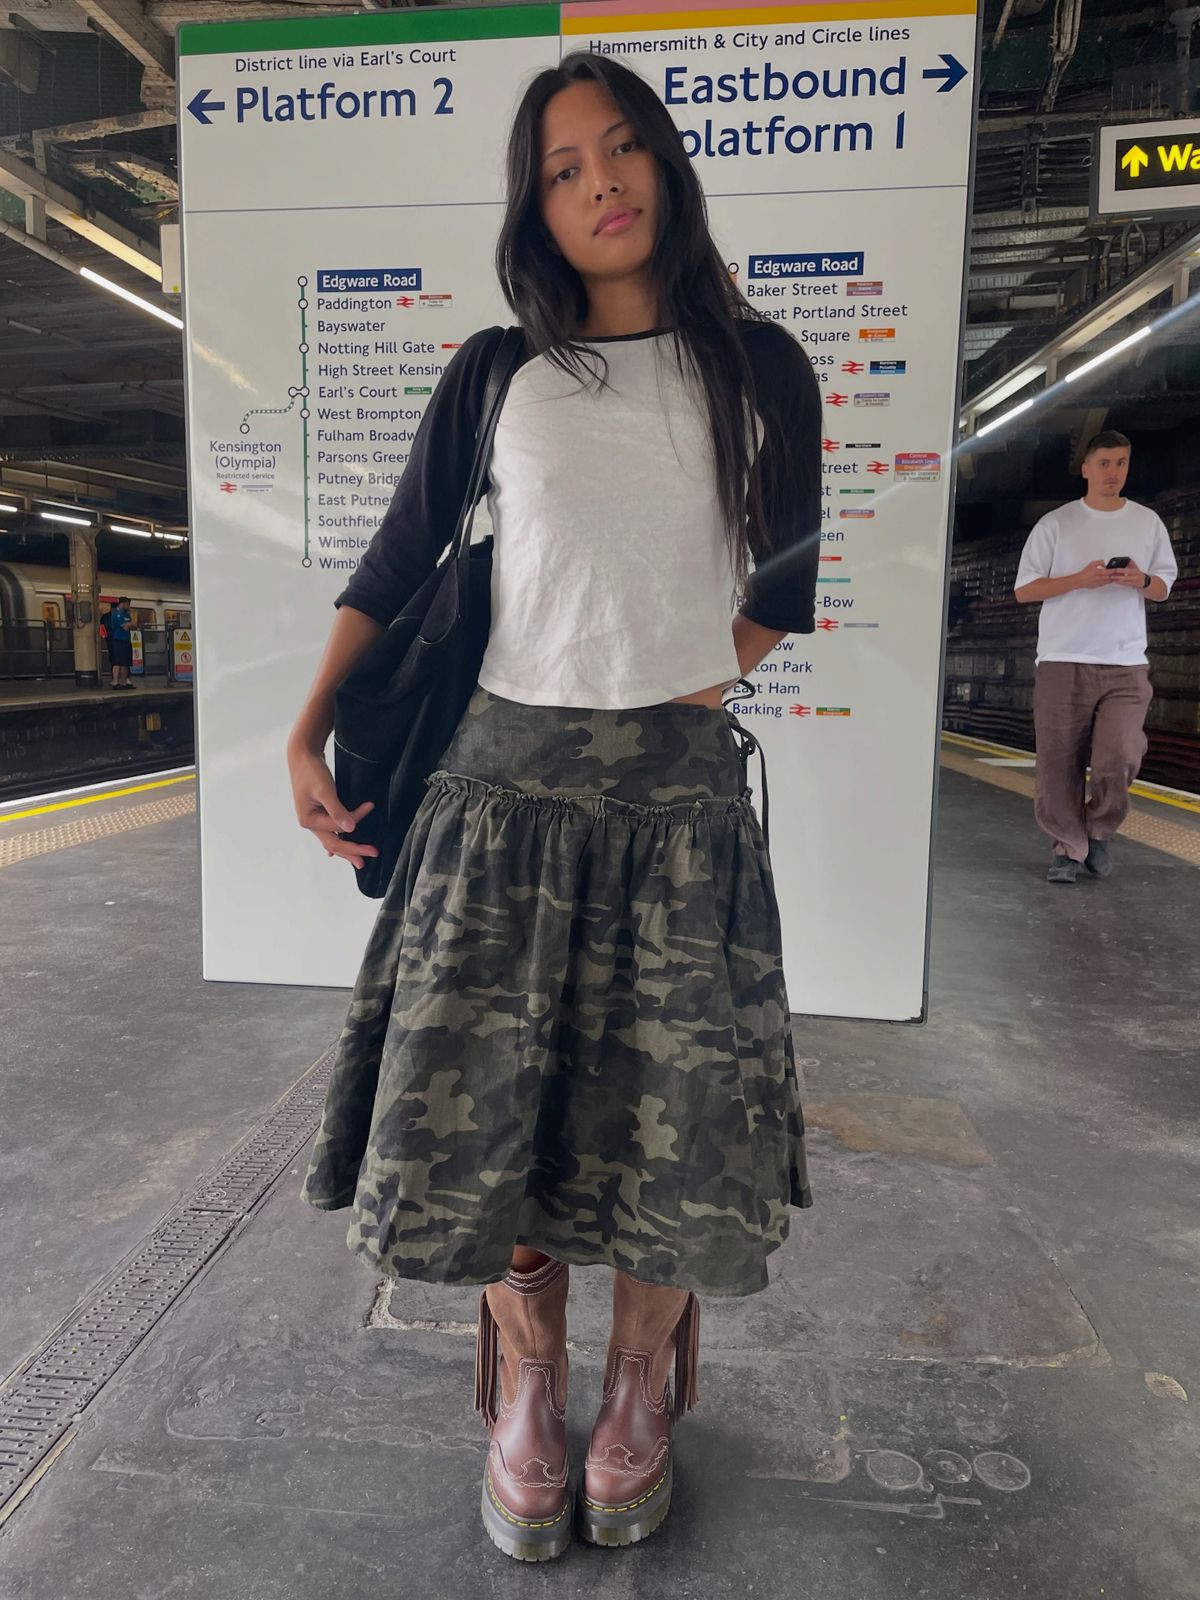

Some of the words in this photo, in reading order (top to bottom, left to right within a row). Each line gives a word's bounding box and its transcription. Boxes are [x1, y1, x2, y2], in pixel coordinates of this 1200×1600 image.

[589, 34, 707, 55] Hammersmith
[714, 34, 726, 49] &
[733, 30, 769, 51] City
[775, 30, 805, 47] and
[812, 27, 862, 44] Circle
[869, 26, 911, 41] lines
[235, 57, 293, 73] District
[299, 55, 327, 70] line
[332, 53, 355, 68] via
[360, 51, 404, 67] Earl's
[409, 49, 456, 65] Court
[664, 57, 906, 105] Eastbound
[236, 82, 416, 123] Platform
[433, 77, 454, 115] 2
[895, 111, 906, 150] 1
[754, 259, 816, 277] Edgware
[821, 257, 859, 272] Road
[322, 275, 379, 291] Edgware
[383, 273, 417, 287] Road
[747, 284, 787, 298] Baker
[792, 282, 838, 296] Street
[317, 297, 392, 312] Paddington
[759, 308, 787, 320] reat
[793, 305, 856, 320] Portland
[861, 304, 908, 318] Street
[317, 320, 386, 335] Bayswater
[801, 329, 850, 345] Square
[318, 342, 370, 357] Notting
[375, 342, 398, 354] Hill
[402, 342, 435, 354] Gate
[810, 355, 835, 366] oss
[318, 364, 348, 379] High
[352, 363, 394, 376] Street
[399, 363, 447, 376] Kensin
[319, 386, 354, 398] Earl's
[359, 386, 398, 398] Court
[317, 408, 352, 420] West
[356, 408, 421, 422] Brompton
[317, 429, 365, 441] Fulham
[369, 429, 416, 441] Broadw
[209, 440, 281, 453] Kensington
[215, 456, 276, 470] (Olympia)
[317, 451, 368, 463] Parsons
[372, 451, 410, 463] Gree
[821, 462, 859, 474] treet
[216, 472, 250, 480] Restricted
[318, 472, 363, 487] Putney
[368, 472, 401, 487] Bridg
[318, 494, 346, 506] East
[351, 494, 392, 506] Putne
[318, 515, 382, 527] Southfiel
[319, 536, 371, 549] Wimble
[319, 557, 359, 569] Wimbl
[783, 661, 813, 673] Park
[768, 682, 800, 694] Ham
[732, 702, 783, 718] Barking
